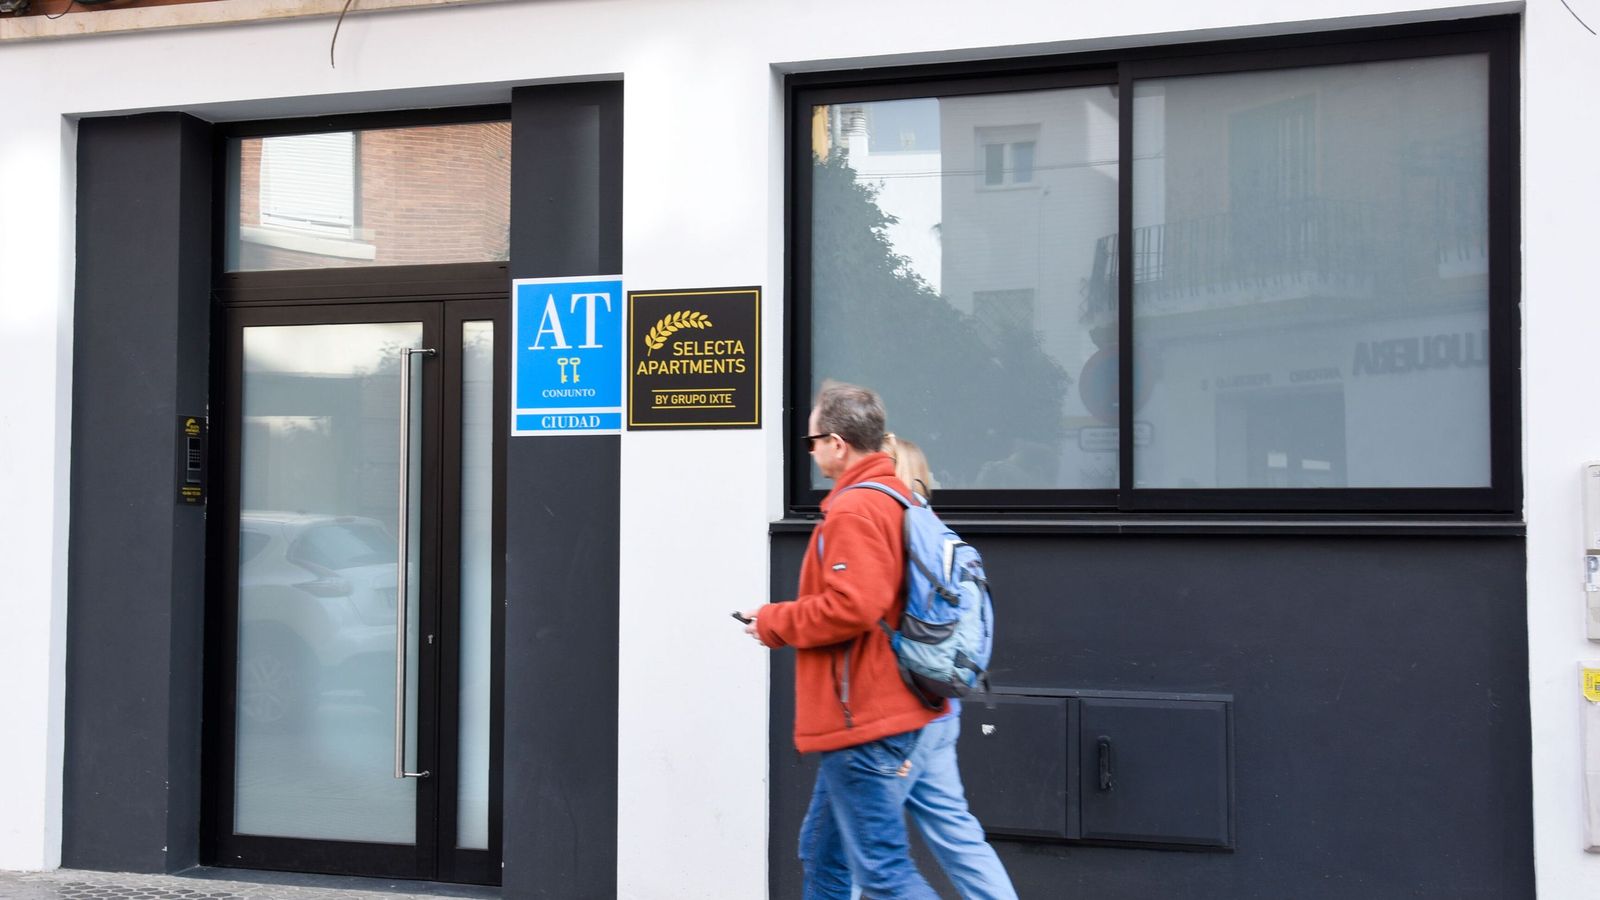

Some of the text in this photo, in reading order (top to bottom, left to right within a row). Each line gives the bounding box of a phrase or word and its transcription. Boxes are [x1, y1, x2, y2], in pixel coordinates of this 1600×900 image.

[527, 292, 612, 351] AT
[672, 340, 745, 357] SELECTA
[636, 358, 746, 376] APARTMENTS
[542, 388, 596, 399] CONJUNTO
[655, 392, 732, 405] BY GRUPO IXTE
[541, 414, 601, 429] CIUDAD
